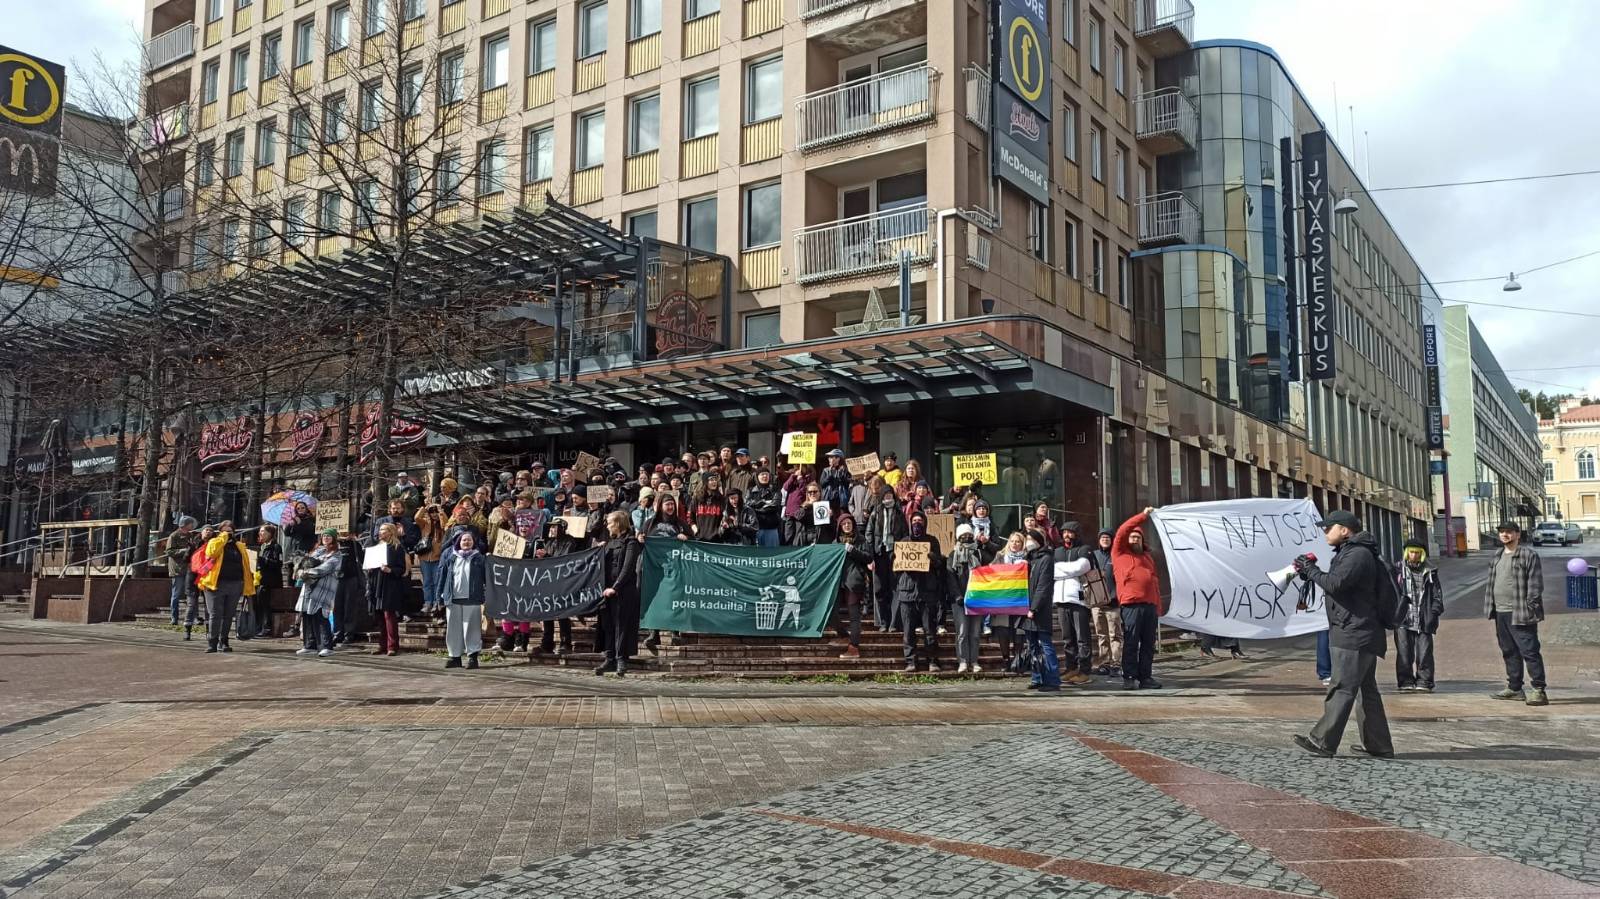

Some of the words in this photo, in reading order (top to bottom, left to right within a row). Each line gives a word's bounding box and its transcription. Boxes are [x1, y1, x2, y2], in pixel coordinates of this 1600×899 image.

[1001, 146, 1048, 192] McDonald's
[1307, 159, 1329, 372] JYVÄSKESKUS
[1426, 326, 1435, 364] GOFORE
[956, 454, 991, 462] NATSISMIN
[960, 471, 984, 481] POIS!
[1161, 518, 1210, 552] EI
[895, 543, 929, 552] NAZIS
[671, 549, 700, 562] Pidä
[703, 553, 759, 568] kaupunki
[761, 559, 808, 569] siistinä!
[901, 552, 923, 561] NOT
[493, 563, 512, 587] EI
[521, 555, 601, 588] NATSEJÄ
[894, 560, 928, 570] WELCOME
[500, 582, 603, 616] JYVÄSKYLÄÄN
[684, 585, 738, 597] Uusnatsit
[672, 600, 698, 610] pois
[700, 601, 748, 612] kaduilta!
